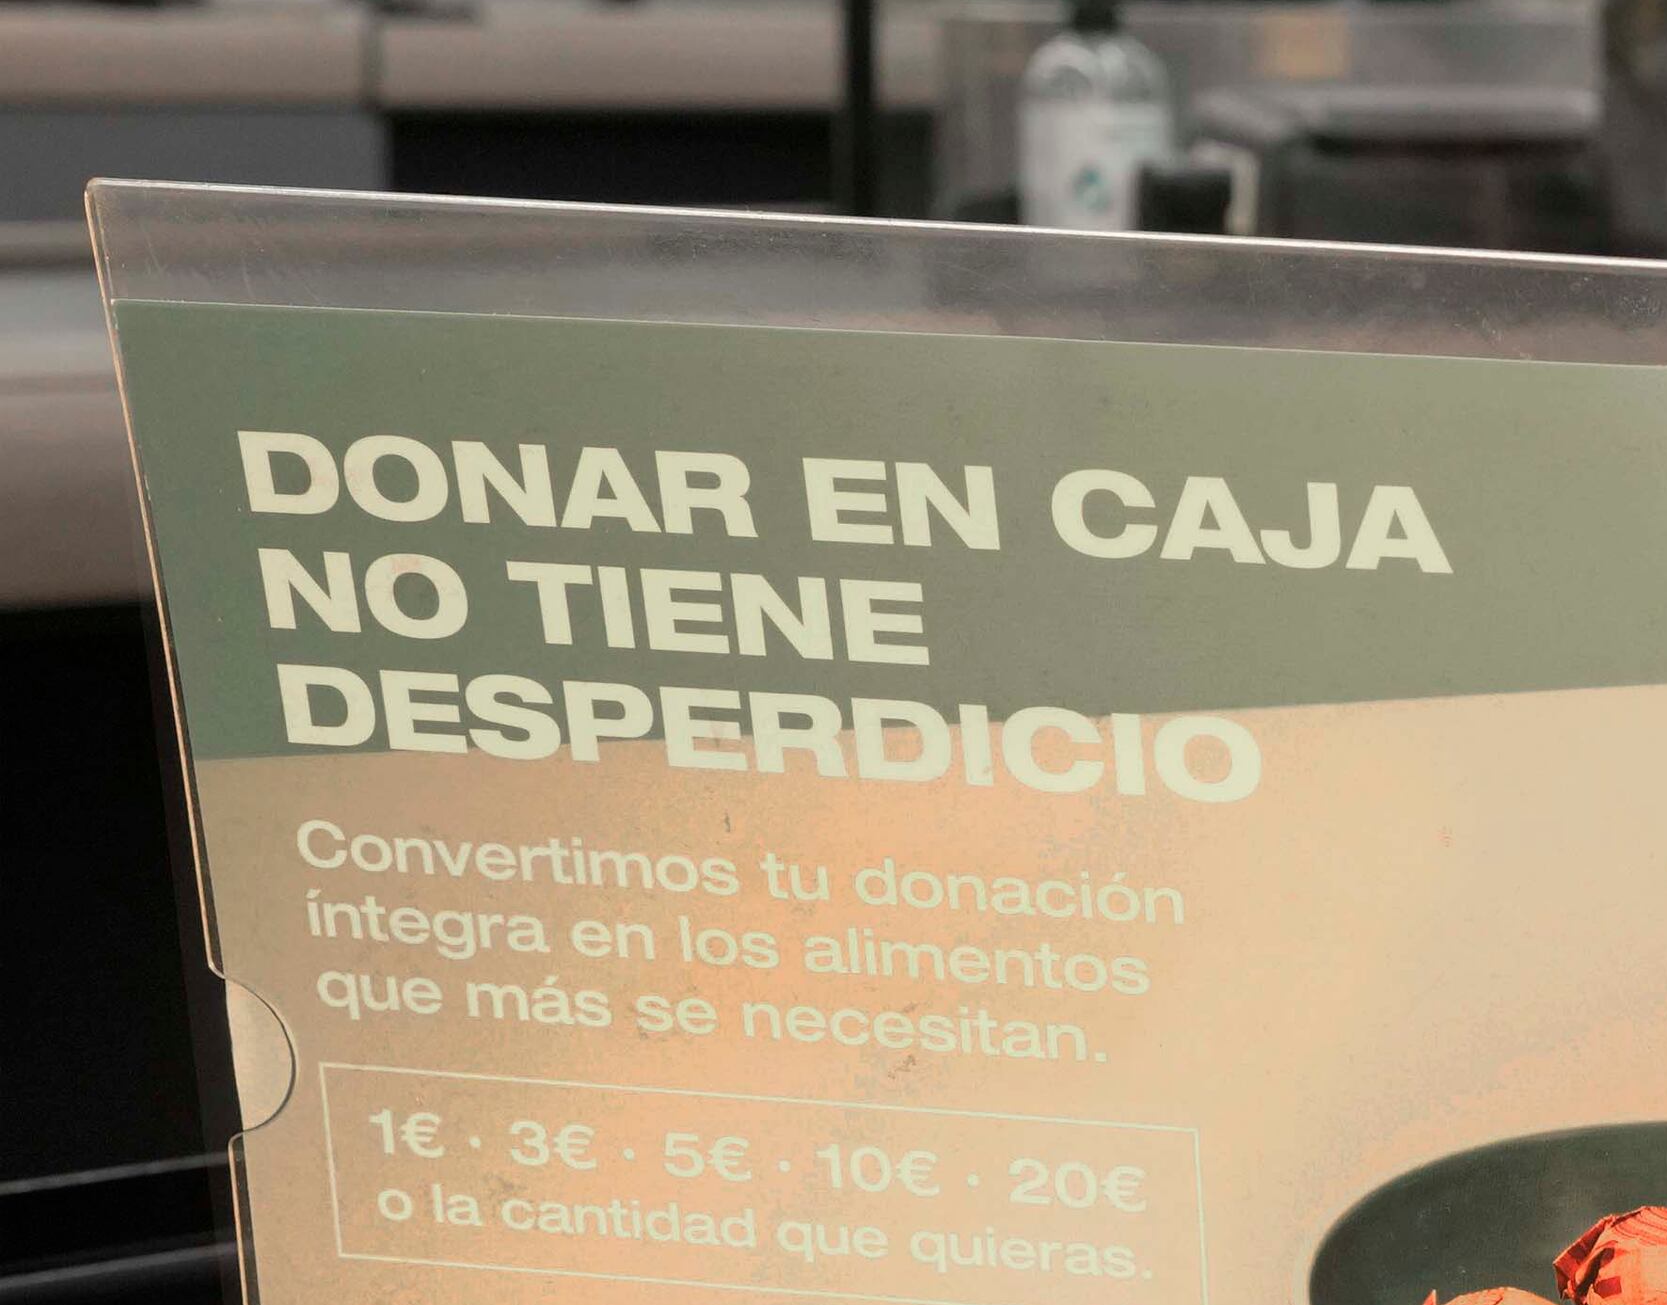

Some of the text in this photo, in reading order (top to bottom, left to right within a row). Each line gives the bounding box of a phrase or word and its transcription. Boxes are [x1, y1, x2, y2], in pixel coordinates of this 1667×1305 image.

[237, 430, 1453, 573] DONAR EN CAJA
[258, 548, 930, 665] NO TIENE
[277, 663, 1262, 802] DESPERDICIO
[295, 819, 1185, 925] Convertimos tu donación
[306, 891, 1150, 997] íntegra en los alimentos
[316, 971, 1107, 1062] que más se necesitan.
[369, 1111, 1147, 1213] 1€ 3€ 5€ 10€ 20€
[376, 1184, 1155, 1282] o la cantidad que quieras.
